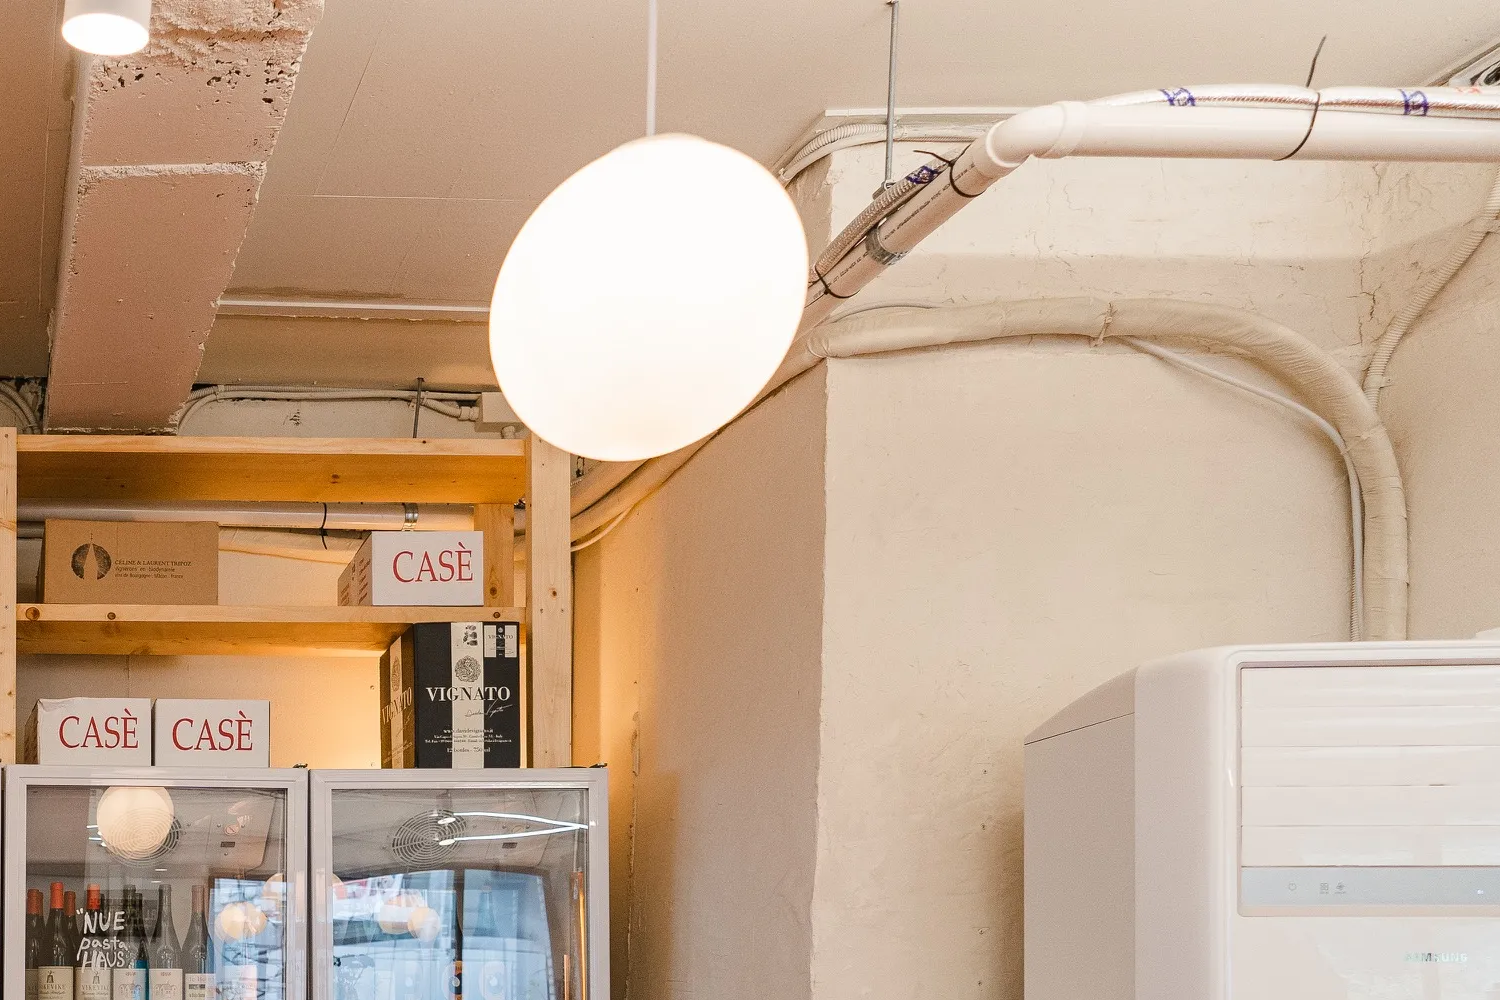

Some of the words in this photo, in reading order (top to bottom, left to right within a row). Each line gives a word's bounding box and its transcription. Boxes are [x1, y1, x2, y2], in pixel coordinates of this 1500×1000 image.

[392, 541, 474, 583] CASÈ
[381, 686, 413, 726] VIGNATO
[426, 686, 511, 702] VIGNATO
[58, 707, 139, 749] CASÈ
[171, 710, 254, 751] CASÈ
[81, 950, 125, 974] HAUS
